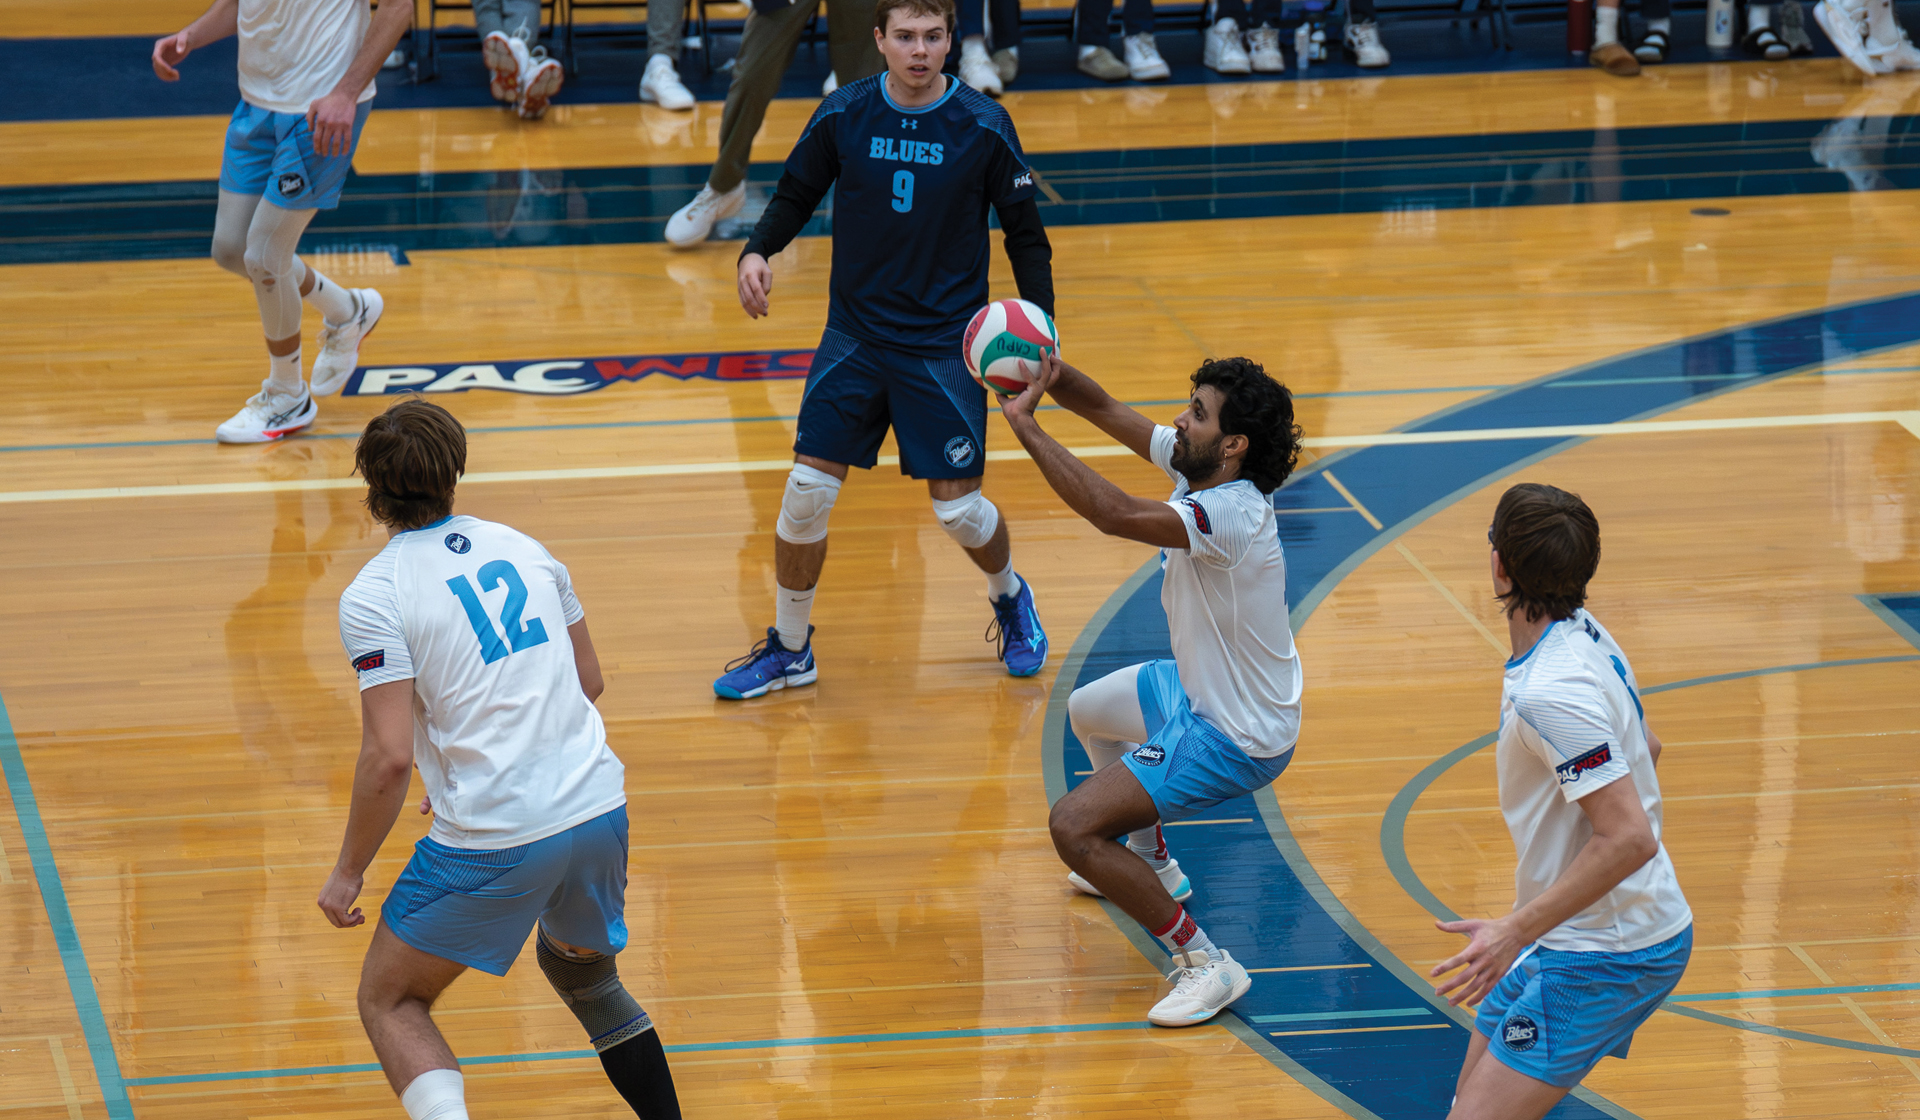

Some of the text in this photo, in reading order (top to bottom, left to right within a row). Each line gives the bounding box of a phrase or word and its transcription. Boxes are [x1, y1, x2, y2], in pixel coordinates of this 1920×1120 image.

[869, 136, 944, 165] BLUES
[891, 169, 915, 213] 9
[997, 336, 1031, 355] CAPU
[445, 559, 549, 666] 12
[1505, 1025, 1535, 1042] Blues
